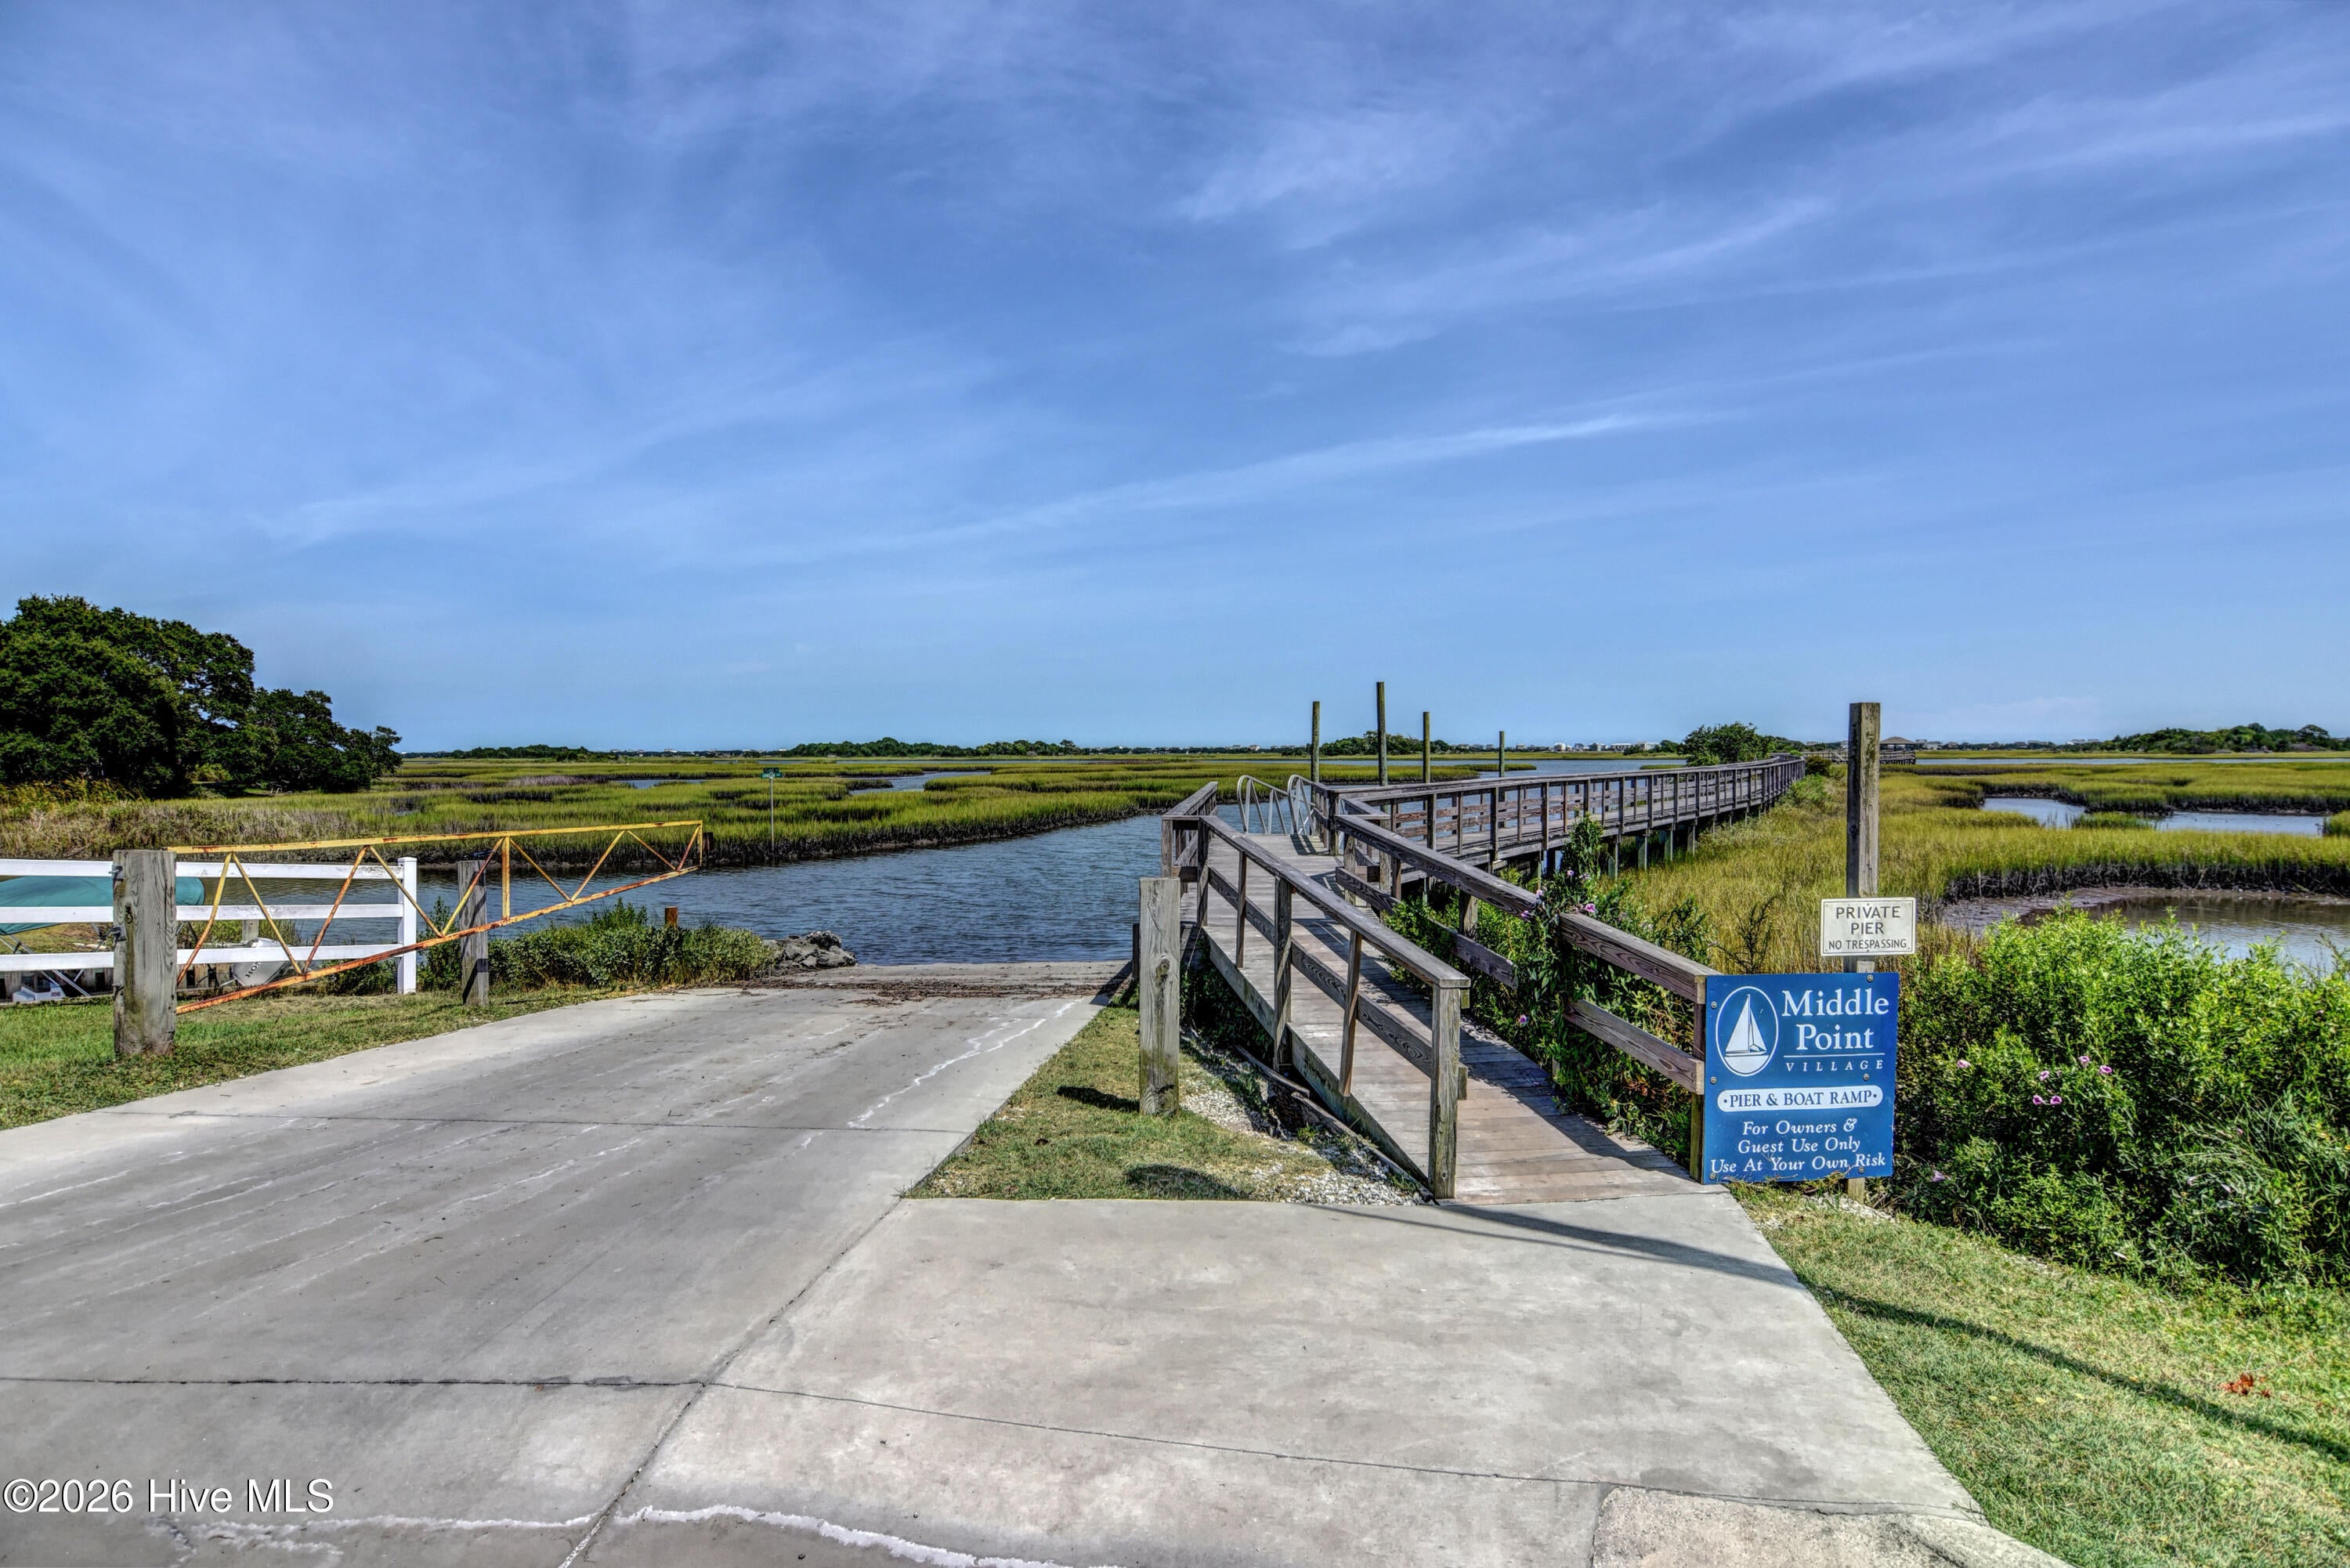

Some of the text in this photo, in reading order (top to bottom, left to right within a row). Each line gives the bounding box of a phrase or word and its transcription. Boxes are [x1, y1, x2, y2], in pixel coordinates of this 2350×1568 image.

[1836, 906, 1900, 919] PRIVATE
[1851, 922, 1885, 934] PIER
[1828, 939, 1907, 950] NO TRESPASSING
[1781, 987, 1889, 1017] Middle
[1796, 1024, 1875, 1050] Point
[1786, 1060, 1883, 1072] VILLAGE
[1730, 1089, 1871, 1107] PIER & BOAT RAMP
[1742, 1118, 1857, 1136] For Owners &
[1737, 1136, 1860, 1154] Guest Use Only
[1711, 1152, 1886, 1173] Use At Your Own Risk
